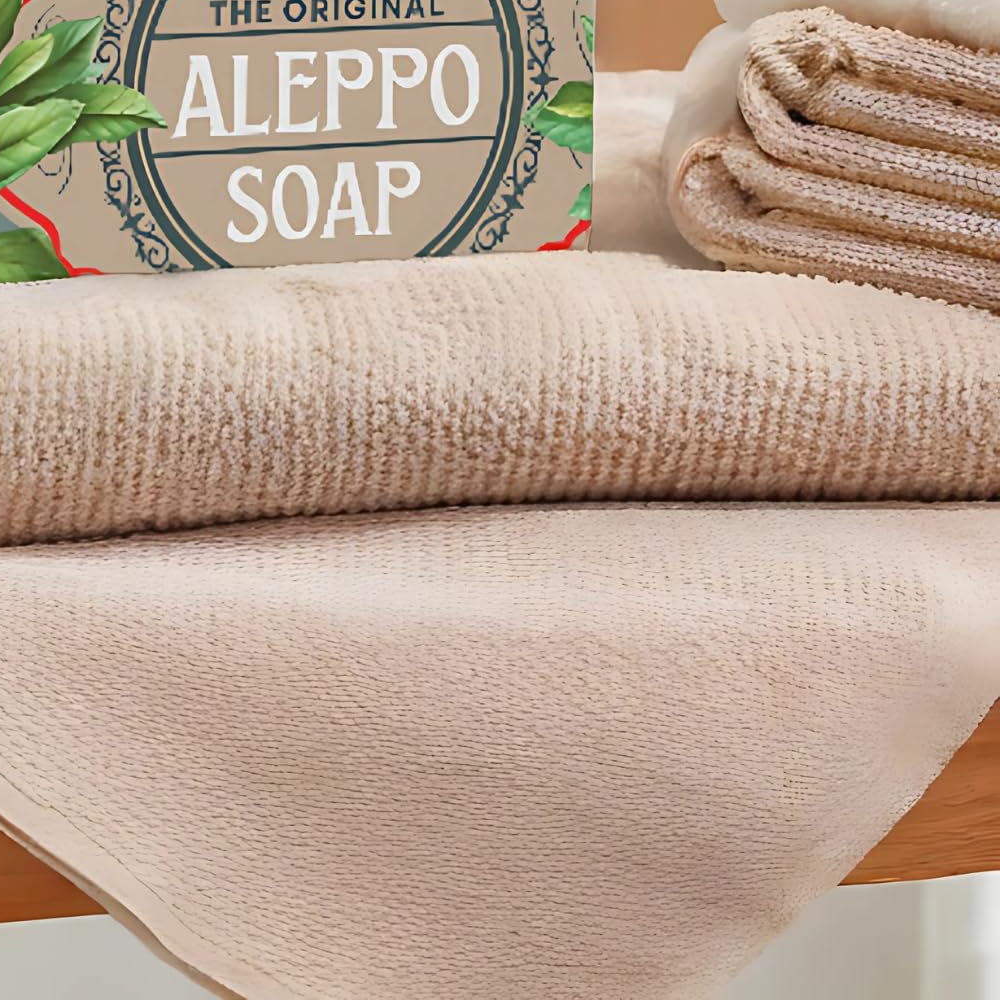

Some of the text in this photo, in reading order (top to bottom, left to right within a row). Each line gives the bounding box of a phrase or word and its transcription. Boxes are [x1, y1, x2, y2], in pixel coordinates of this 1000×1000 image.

[209, 0, 273, 27] THE
[170, 43, 481, 140] ALEPPO
[226, 159, 422, 244] SOAP
